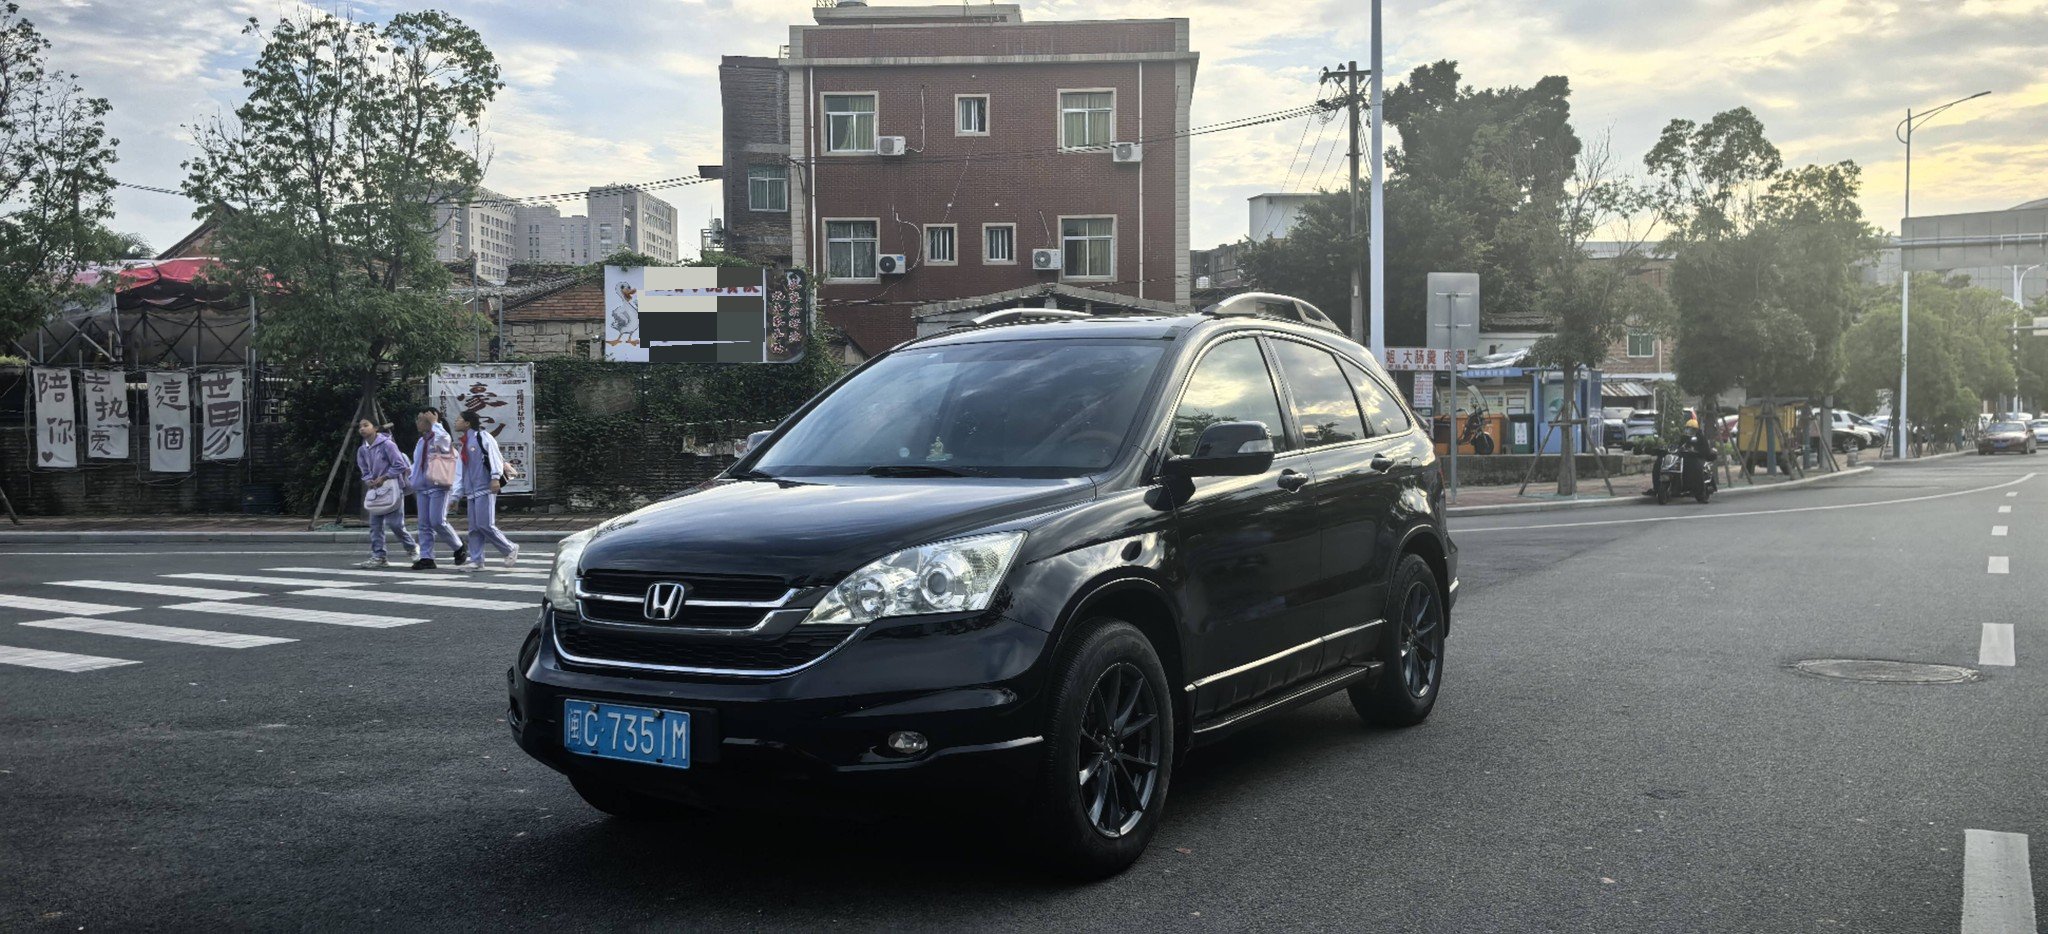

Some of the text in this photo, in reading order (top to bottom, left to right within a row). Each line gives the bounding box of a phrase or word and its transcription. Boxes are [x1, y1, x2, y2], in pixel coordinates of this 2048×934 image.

[37, 372, 74, 445] 陪你
[154, 378, 187, 451] 這個
[200, 370, 242, 456] 世界
